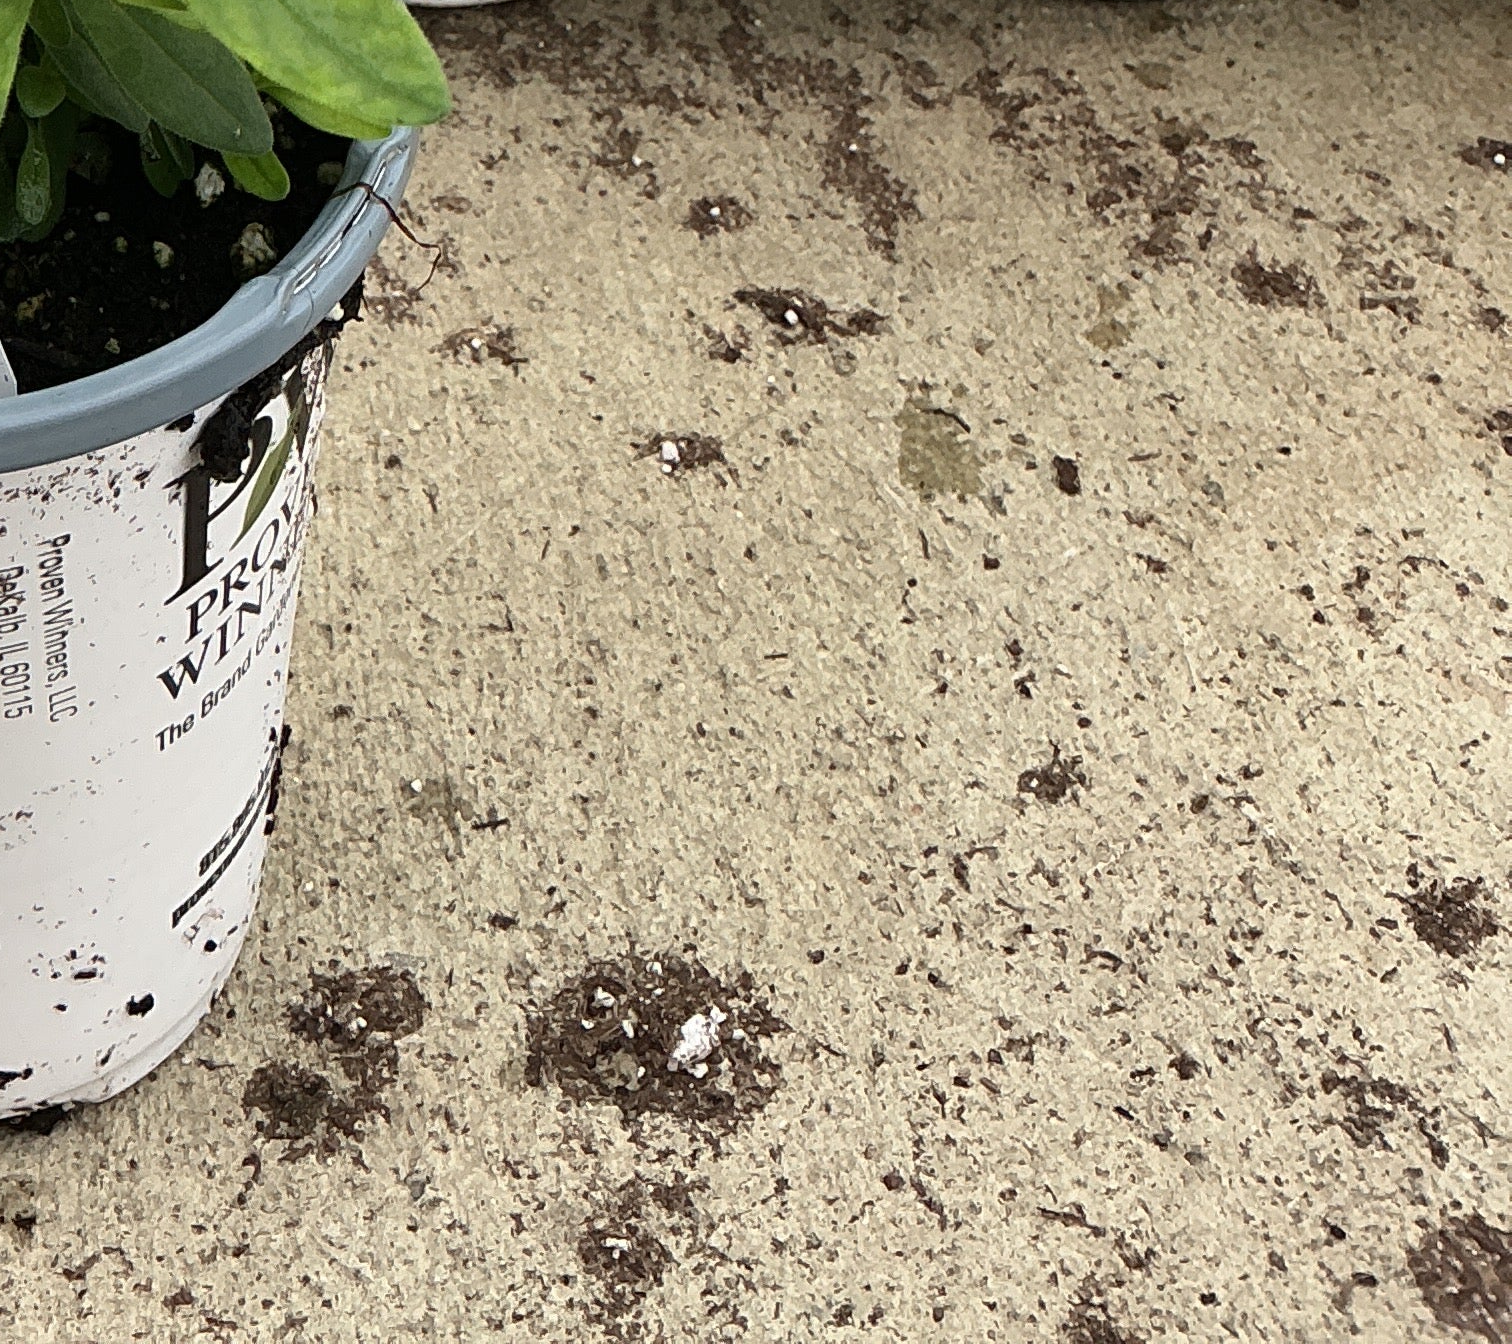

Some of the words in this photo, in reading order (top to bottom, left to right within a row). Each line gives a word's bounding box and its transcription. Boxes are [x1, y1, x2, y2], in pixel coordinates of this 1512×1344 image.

[37, 533, 71, 602] Proven
[42, 598, 74, 689] Winners,
[0, 661, 33, 719] 60115
[48, 685, 78, 723] LLC
[155, 710, 196, 752] The
[200, 647, 252, 720] Brand
